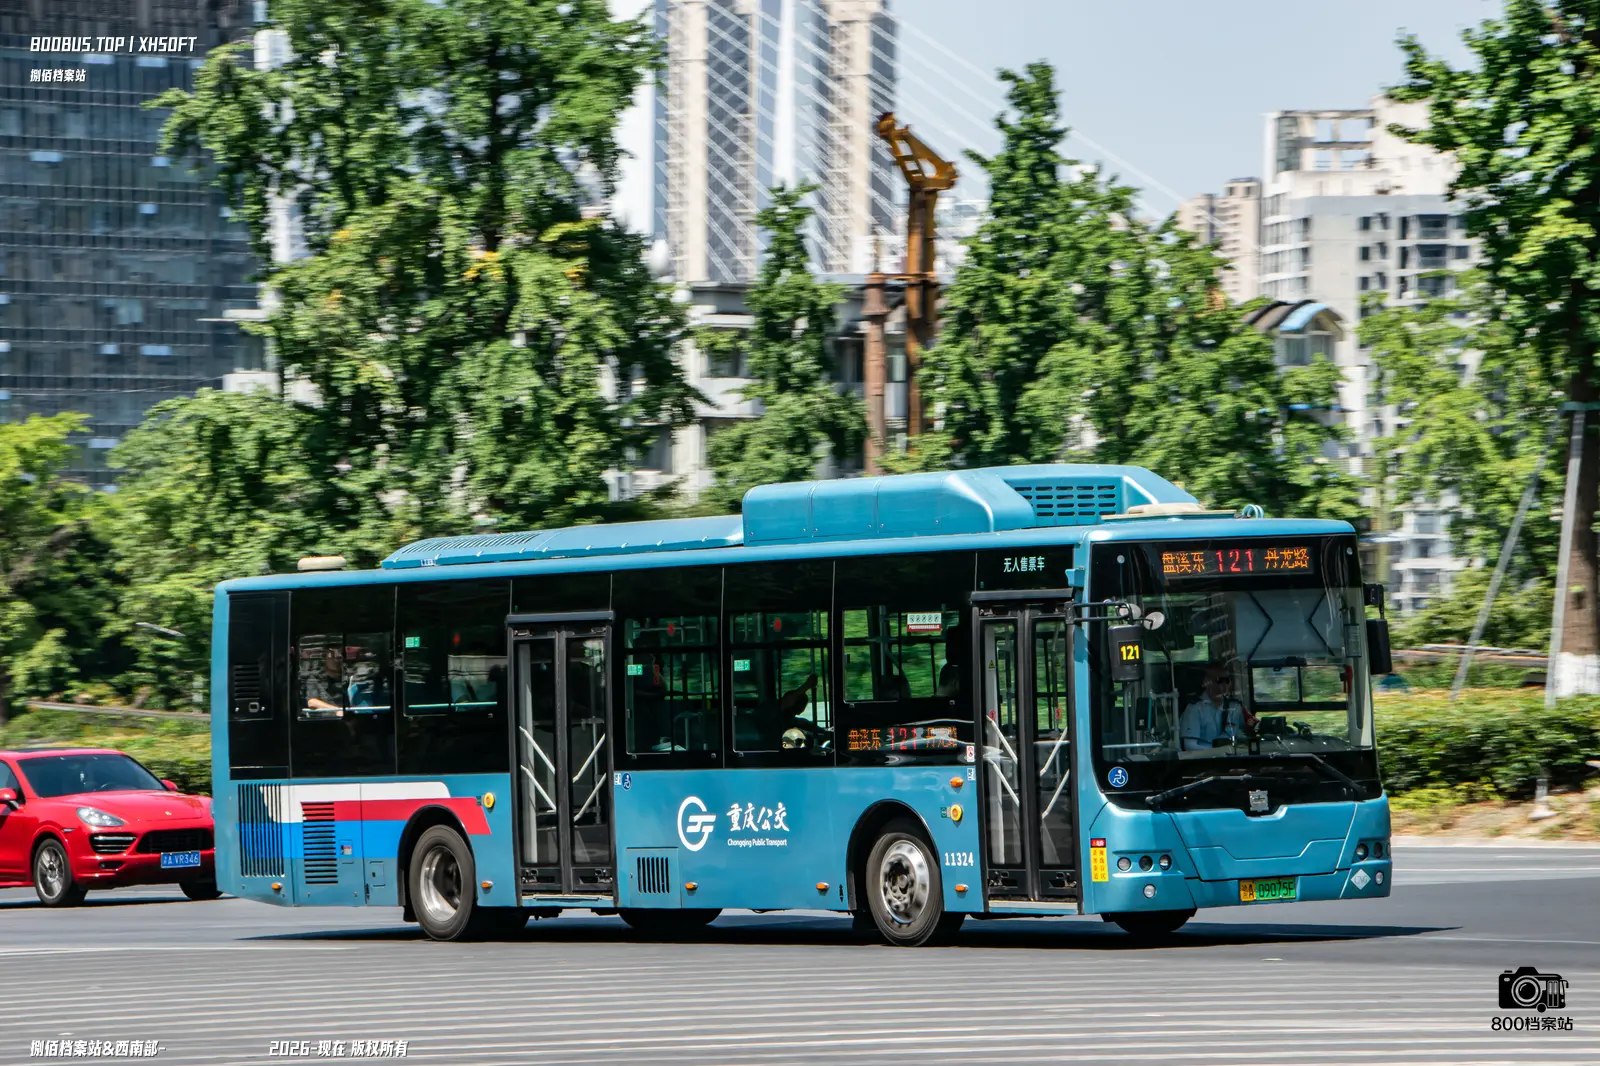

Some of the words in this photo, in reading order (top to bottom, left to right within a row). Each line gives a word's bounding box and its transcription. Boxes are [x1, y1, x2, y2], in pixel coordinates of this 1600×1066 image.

[1003, 555, 1046, 573] 无人售票车
[1215, 548, 1254, 573] 121
[1264, 547, 1310, 570] 丹龙路
[1120, 644, 1140, 661] 121
[888, 727, 917, 751] 121
[726, 802, 790, 832] 重庆公交
[727, 838, 752, 848] Chongqing
[752, 838, 766, 847] Public
[765, 838, 788, 848] Transport
[944, 851, 974, 867] 11324
[1258, 881, 1294, 898] 09075F
